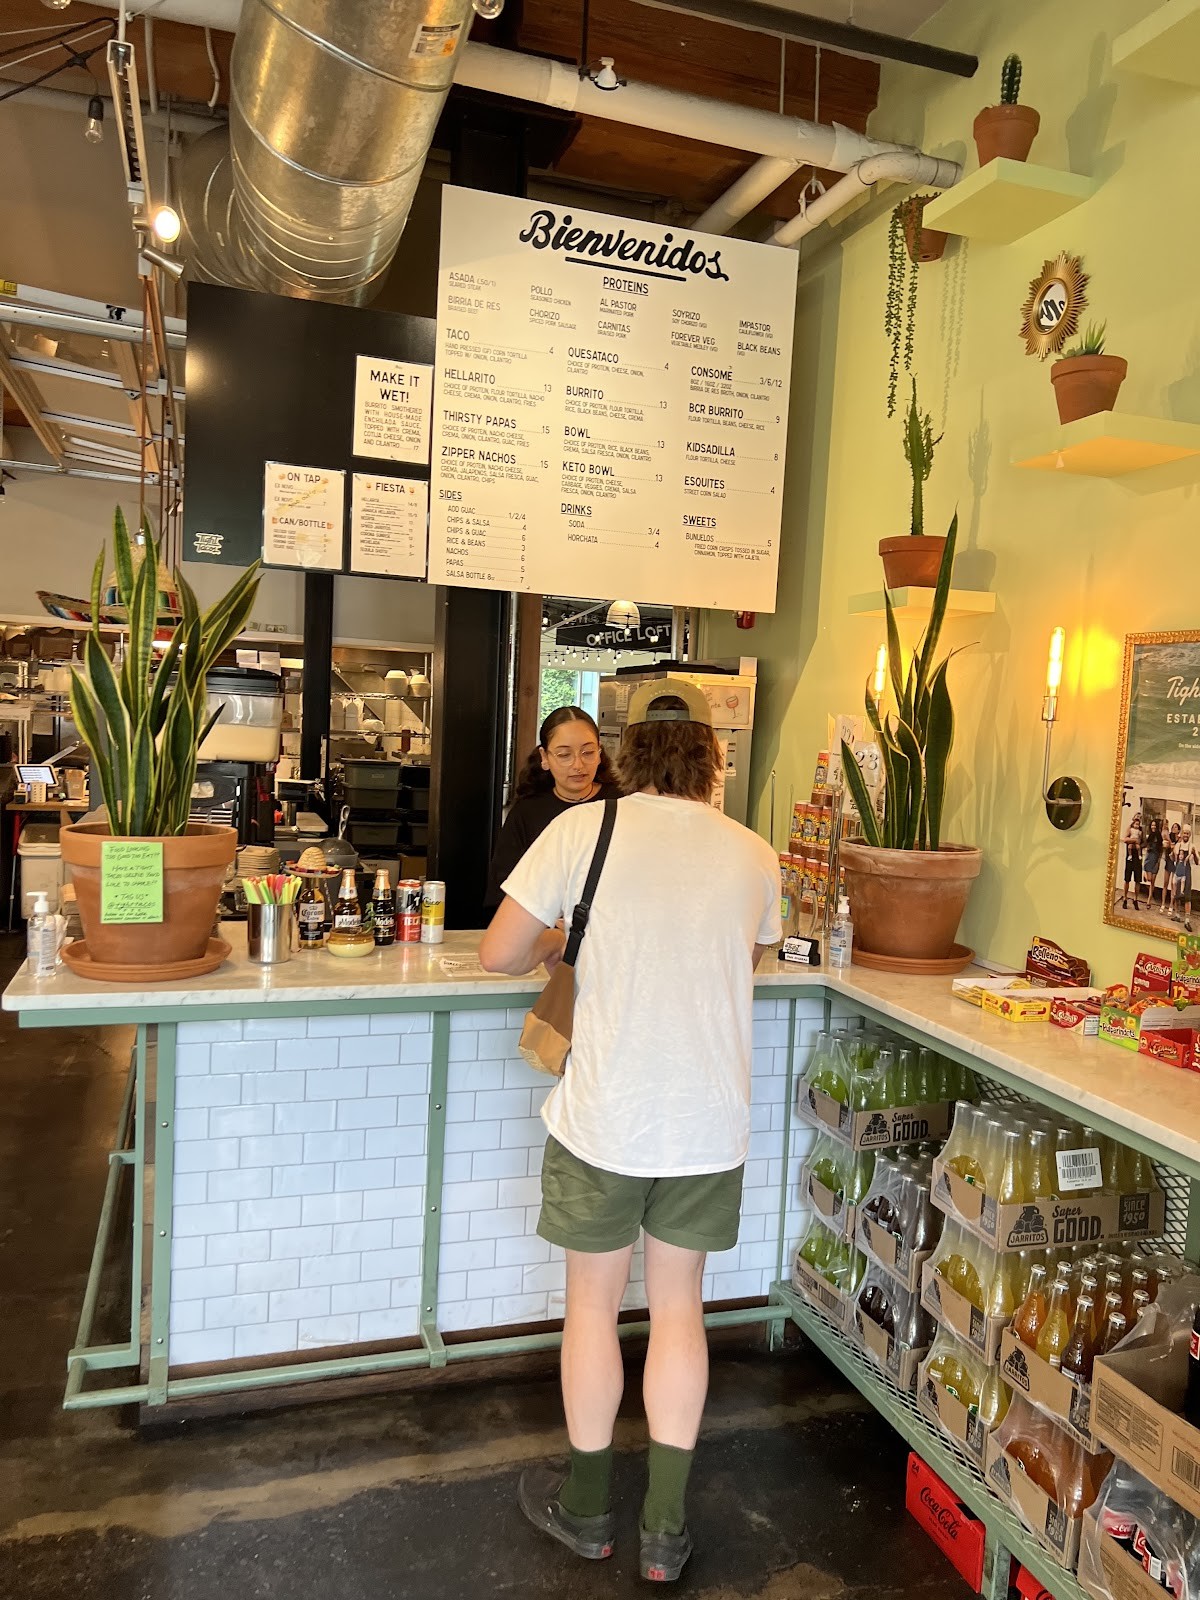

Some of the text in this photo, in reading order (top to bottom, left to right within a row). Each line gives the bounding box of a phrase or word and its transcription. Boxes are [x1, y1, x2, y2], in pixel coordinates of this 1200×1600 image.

[519, 210, 730, 282] Bienvenidos
[449, 272, 475, 283] ASADA
[530, 285, 553, 296] POLLO
[603, 277, 649, 294] PROTEINS
[448, 295, 501, 311] BIRRIA DE RES
[600, 298, 637, 311] AL PASTOR
[530, 309, 560, 321] CHORIZO
[672, 309, 700, 321] SOYRIZO
[598, 321, 631, 333] CARNITAS
[739, 320, 771, 332] IMPASTOR
[446, 328, 470, 341] TACO
[671, 332, 716, 346] FOREVER VEG
[568, 347, 619, 364] QUESATACO
[738, 342, 781, 356] BLACK BEANS
[370, 370, 420, 387] MAKE IT
[444, 368, 552, 392] HELLARITO 13
[691, 366, 782, 388] CONSOME 3/6/12
[380, 388, 409, 403] WET!
[566, 386, 667, 409] BURRITO 13
[364, 401, 422, 414] BURRITO SMOTHERED
[689, 403, 706, 414] BCR
[709, 406, 744, 419] BURRITO
[364, 416, 396, 425] ENCHILADA
[443, 410, 550, 434] THIRSTY PAPAS 15
[364, 423, 384, 432] TOPPED
[564, 426, 664, 449] BOWL 13
[686, 442, 735, 457] KIDSADILLA
[442, 446, 549, 468] ZIPPER NACHOS 15
[287, 472, 321, 483] ON TAP
[562, 461, 663, 482] KETO BOWL 13
[376, 482, 406, 494] FIESTA
[684, 476, 725, 489] ESQUITES
[439, 490, 462, 500] SIDES
[461, 506, 476, 514] GUAC
[508, 512, 526, 520] 1/2/4
[561, 503, 592, 515] DRINKS
[279, 516, 326, 529] CAN/BOTTLE
[683, 515, 716, 526] SWEETS
[568, 520, 660, 536] SODA 3/4
[568, 534, 598, 544] HORCHATA
[686, 533, 714, 542] BUNUELOS
[446, 548, 469, 556] NACHOS
[446, 570, 464, 578] SALSA
[466, 572, 486, 580] BOTTLE
[586, 624, 671, 646] OFFICE LOFT
[1166, 714, 1200, 723] ESTA
[892, 1113, 915, 1122] Super
[862, 1134, 888, 1143] JARRITOS
[1052, 1205, 1083, 1219] Super
[1124, 1199, 1145, 1212] SINCE
[1123, 1212, 1145, 1225] 1950
[1010, 1232, 1045, 1244] JARRITOS
